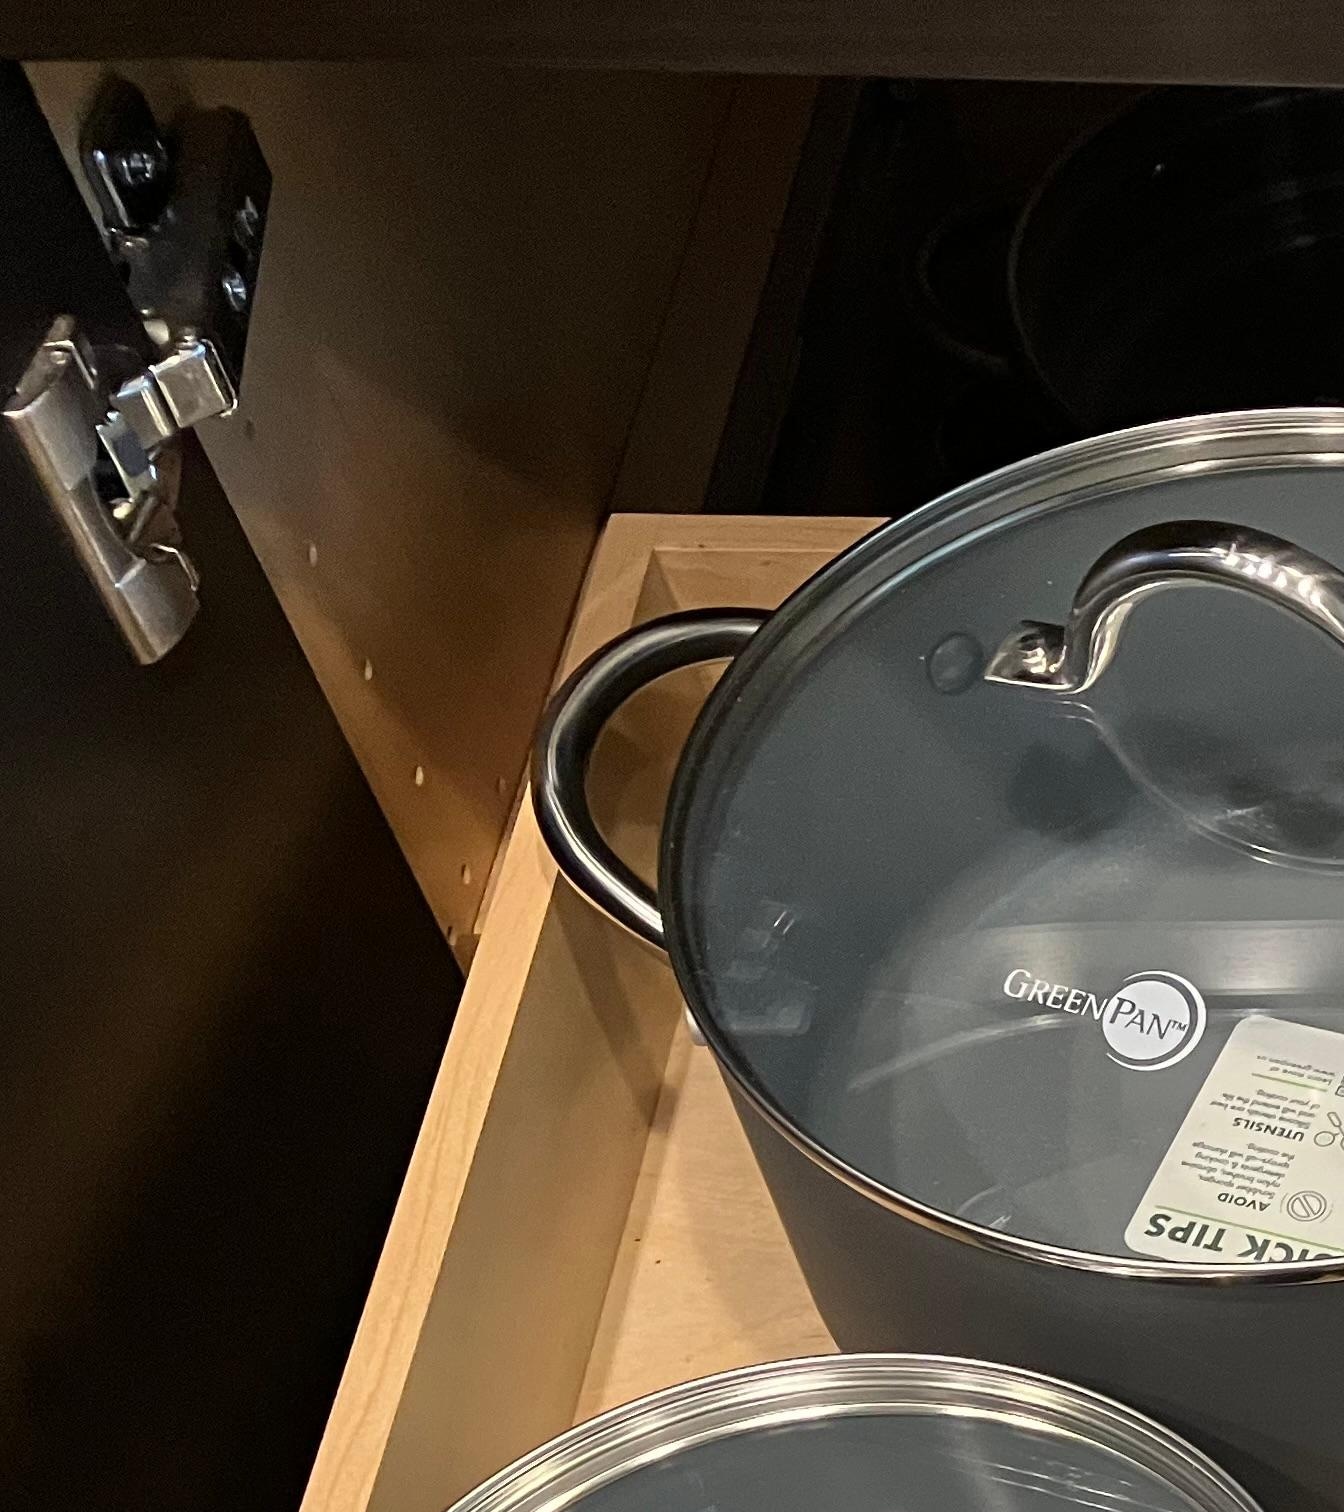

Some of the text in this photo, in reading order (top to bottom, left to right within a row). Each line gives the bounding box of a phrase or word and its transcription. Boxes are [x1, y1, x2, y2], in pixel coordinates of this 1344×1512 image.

[1232, 1117, 1304, 1141] UTENSILS
[1217, 1192, 1270, 1211] AVOID
[1143, 1213, 1336, 1263] ICK TIPS
